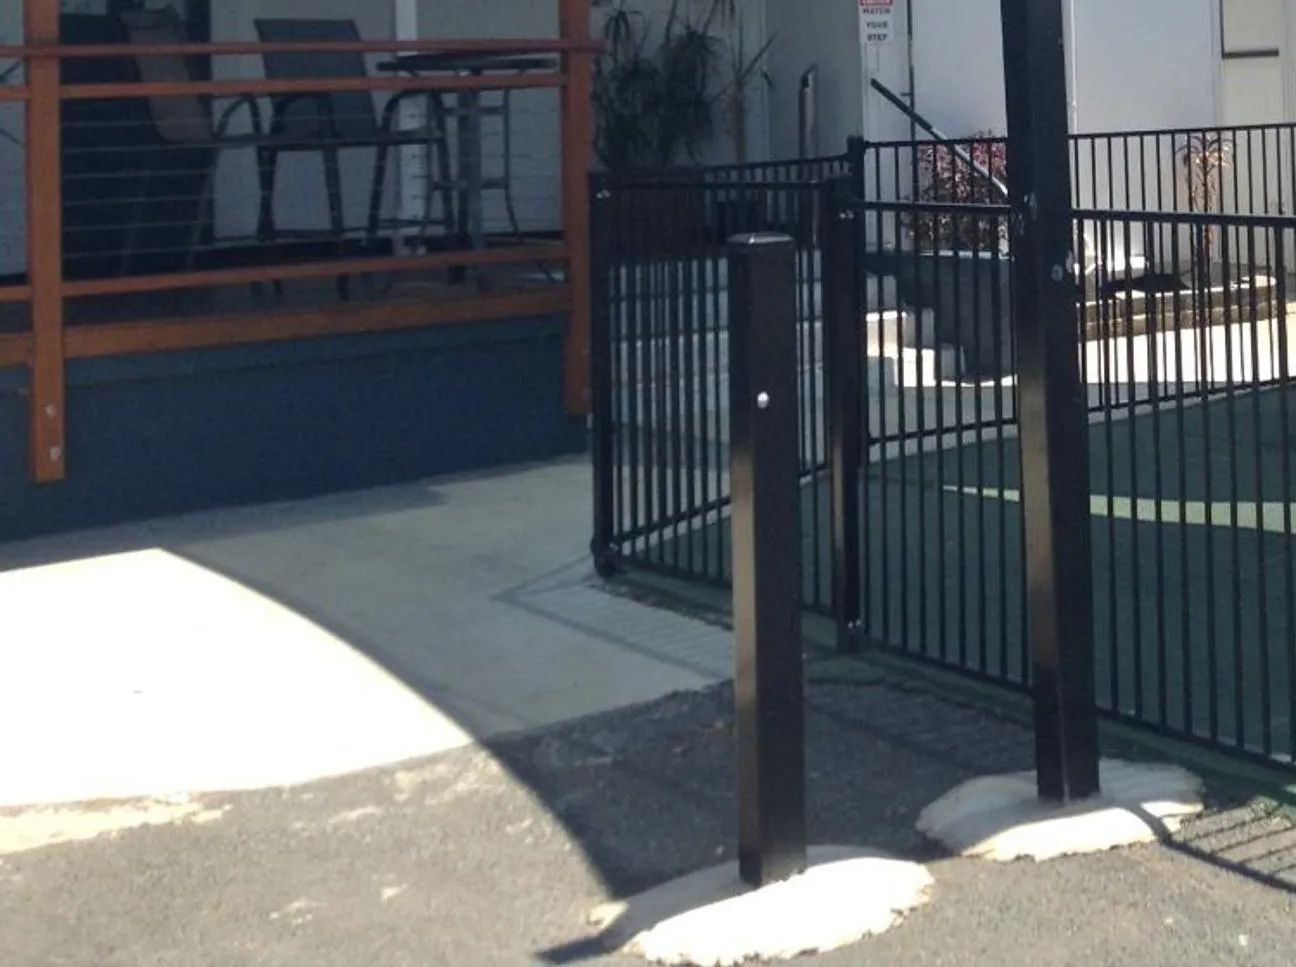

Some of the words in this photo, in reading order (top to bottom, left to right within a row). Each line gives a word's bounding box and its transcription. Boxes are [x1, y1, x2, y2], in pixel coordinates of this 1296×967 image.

[862, 7, 891, 15] WATCH
[866, 20, 888, 29] YOUR
[867, 33, 888, 42] STEP
